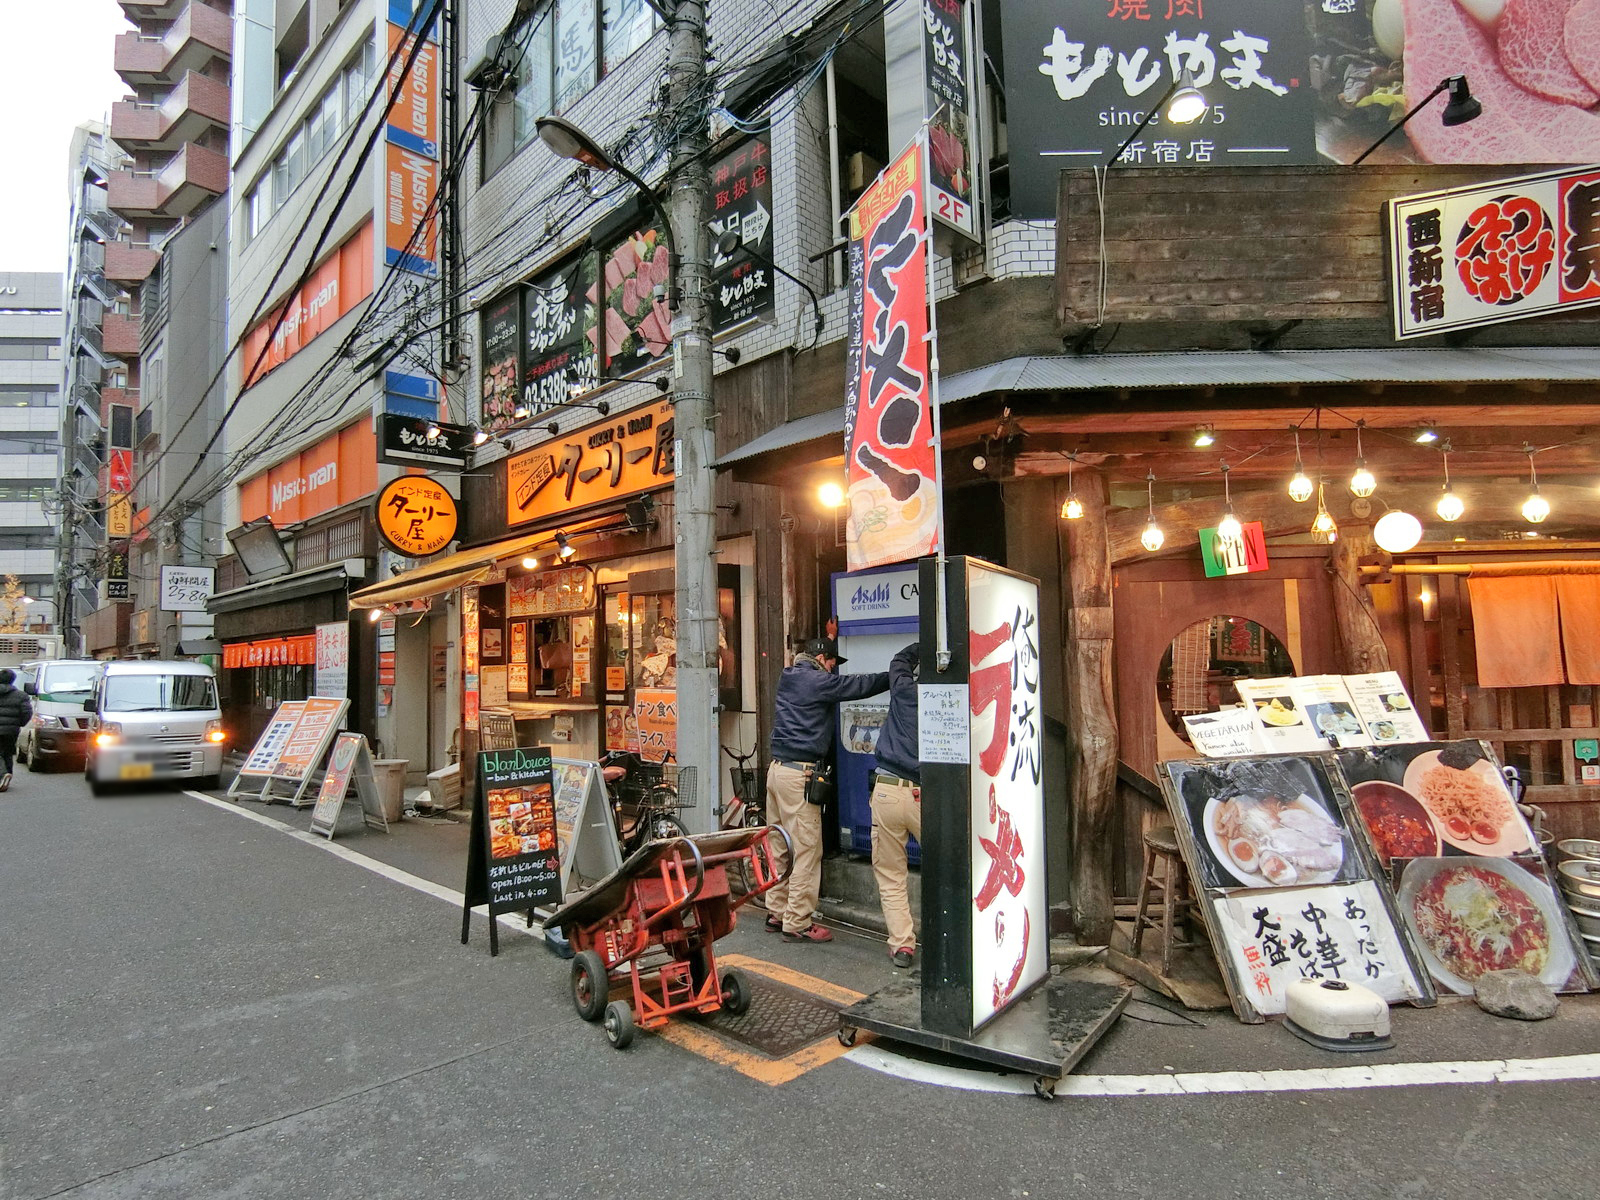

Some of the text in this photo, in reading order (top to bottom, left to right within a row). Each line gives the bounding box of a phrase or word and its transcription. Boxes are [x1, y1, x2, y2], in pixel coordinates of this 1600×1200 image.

[931, 75, 963, 108] 新宿店
[1099, 107, 1159, 127] since
[1117, 139, 1215, 163] 新宿店
[714, 142, 767, 187] 神戸牛
[714, 166, 767, 210] 取扱店
[938, 192, 964, 223] 2F
[744, 213, 764, 229] 階段は
[745, 223, 764, 238] こちら
[1406, 208, 1444, 323] 西新宿
[310, 279, 337, 319] man
[494, 320, 507, 333] OPEN
[425, 380, 436, 398] 1
[309, 461, 337, 492] man
[399, 486, 442, 500] インド定食
[387, 493, 451, 521] ターリー
[406, 518, 424, 540] 屋
[390, 530, 446, 551] CURRY & NAAN
[851, 582, 890, 604] Asahi
[851, 602, 890, 611] SOFT DRINKS
[640, 730, 666, 747] ライス
[1191, 720, 1254, 739] VEGETARIAN
[969, 621, 1029, 1011] ラーメン
[491, 878, 514, 891] open
[514, 889, 525, 899] in
[527, 887, 548, 897] 4:00
[1252, 905, 1292, 967] 大盛
[1301, 902, 1346, 979] 中華
[1345, 897, 1386, 979] あったか
